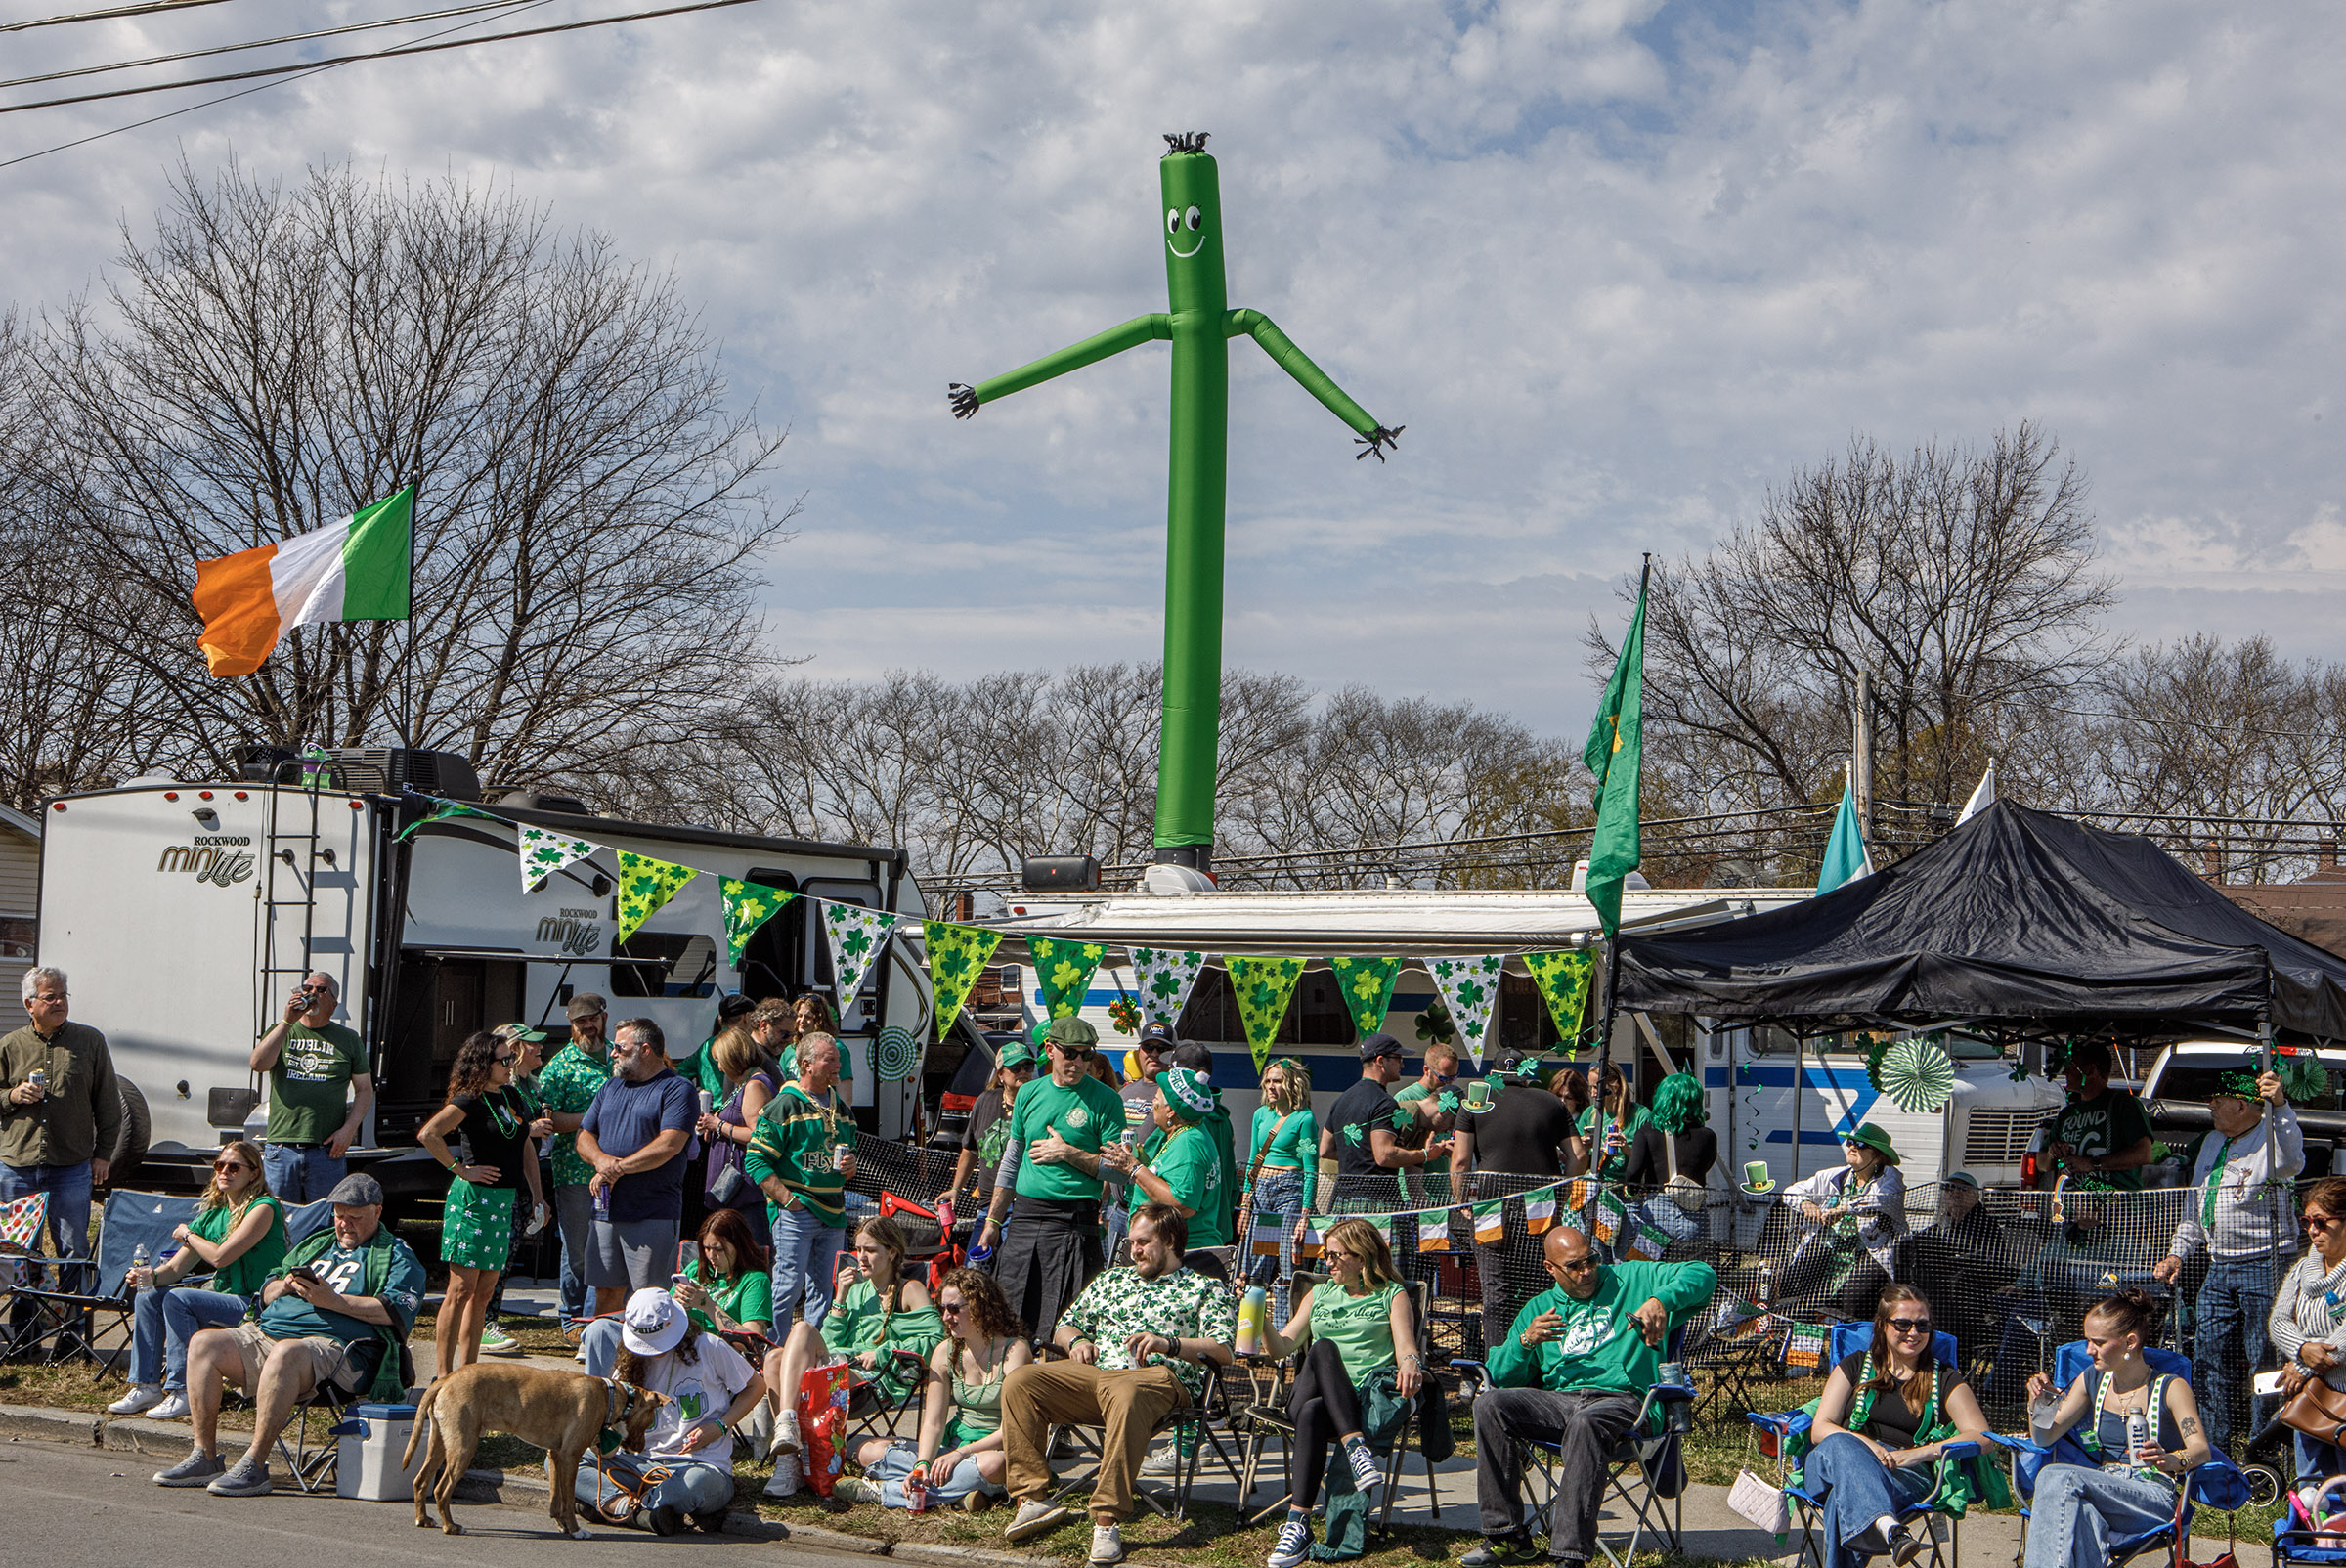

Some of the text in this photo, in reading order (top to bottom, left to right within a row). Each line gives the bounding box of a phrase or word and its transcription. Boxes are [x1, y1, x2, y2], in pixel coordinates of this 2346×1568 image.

[194, 836, 251, 847] ROCKWOOD
[196, 849, 255, 888] Lite
[559, 907, 598, 919] ROCKWOOD
[288, 1038, 335, 1056] DUBLIN
[286, 1068, 327, 1082] IRELAND
[2062, 1110, 2107, 1132] FOUND
[2061, 1129, 2083, 1143] THE
